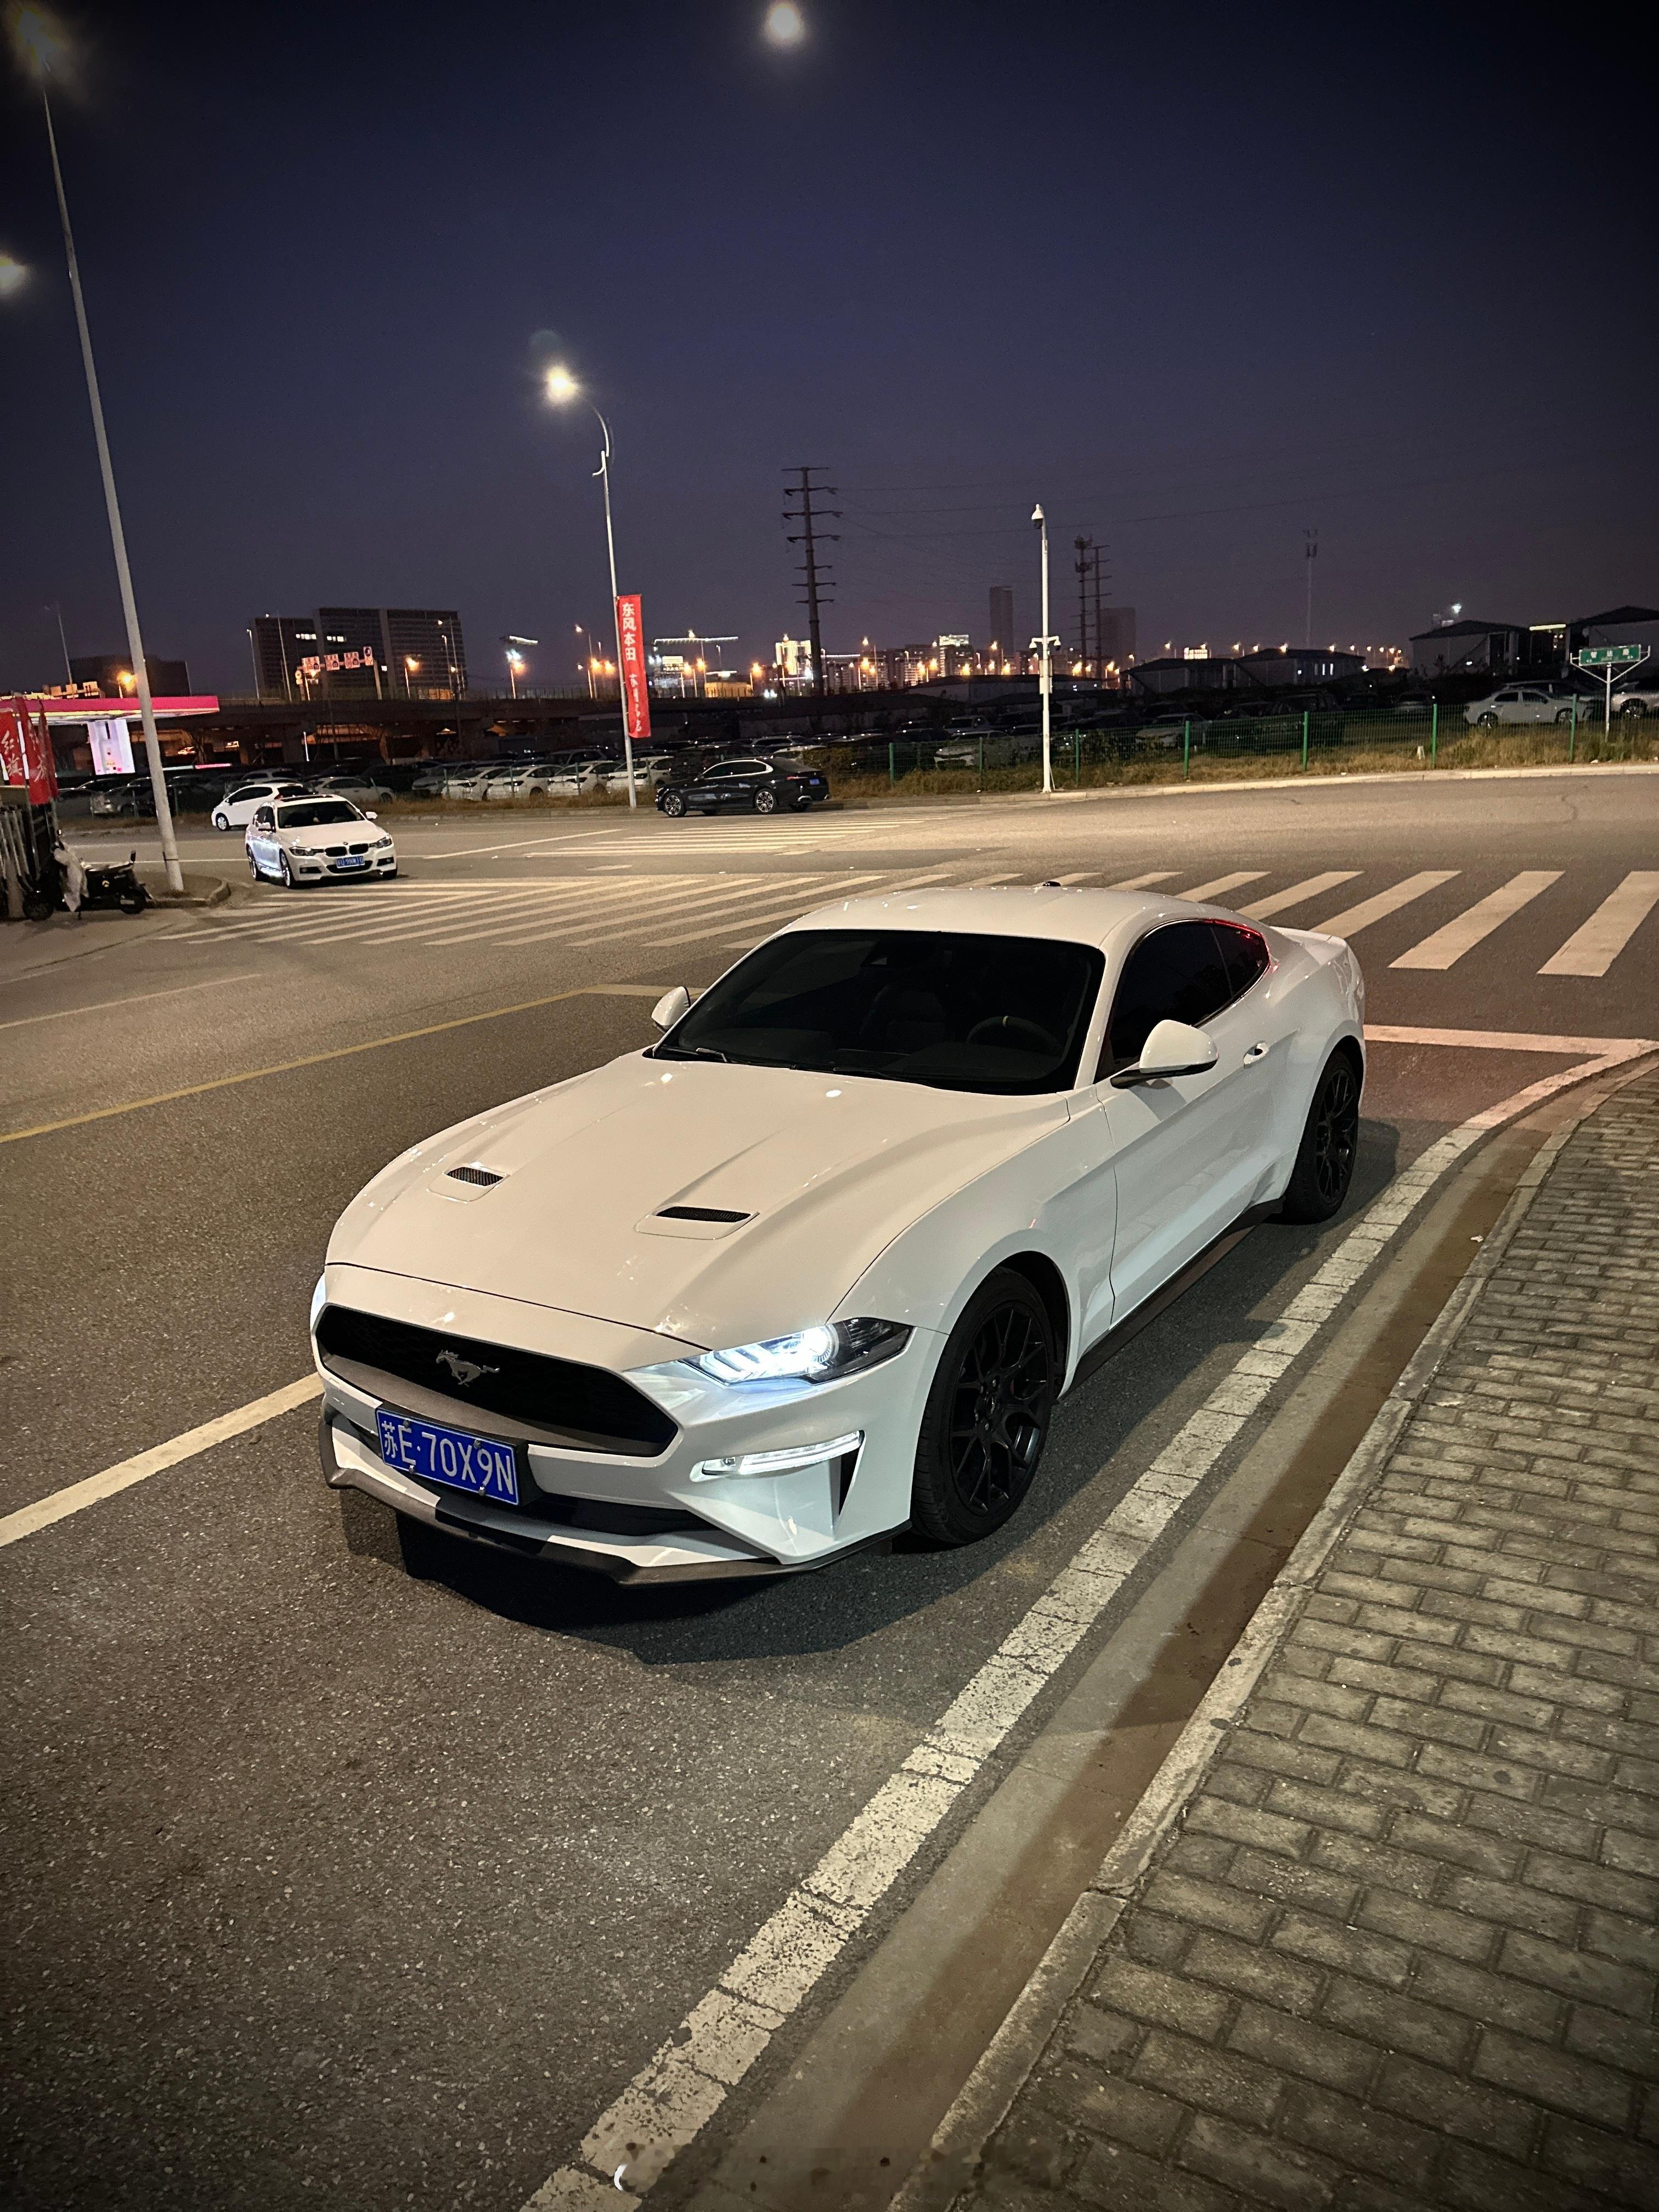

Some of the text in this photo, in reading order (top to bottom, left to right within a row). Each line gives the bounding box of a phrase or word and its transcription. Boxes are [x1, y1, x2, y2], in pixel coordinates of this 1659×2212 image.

[622, 602, 636, 661] 东风本田
[381, 1421, 514, 1494] 苏E·70X9N
